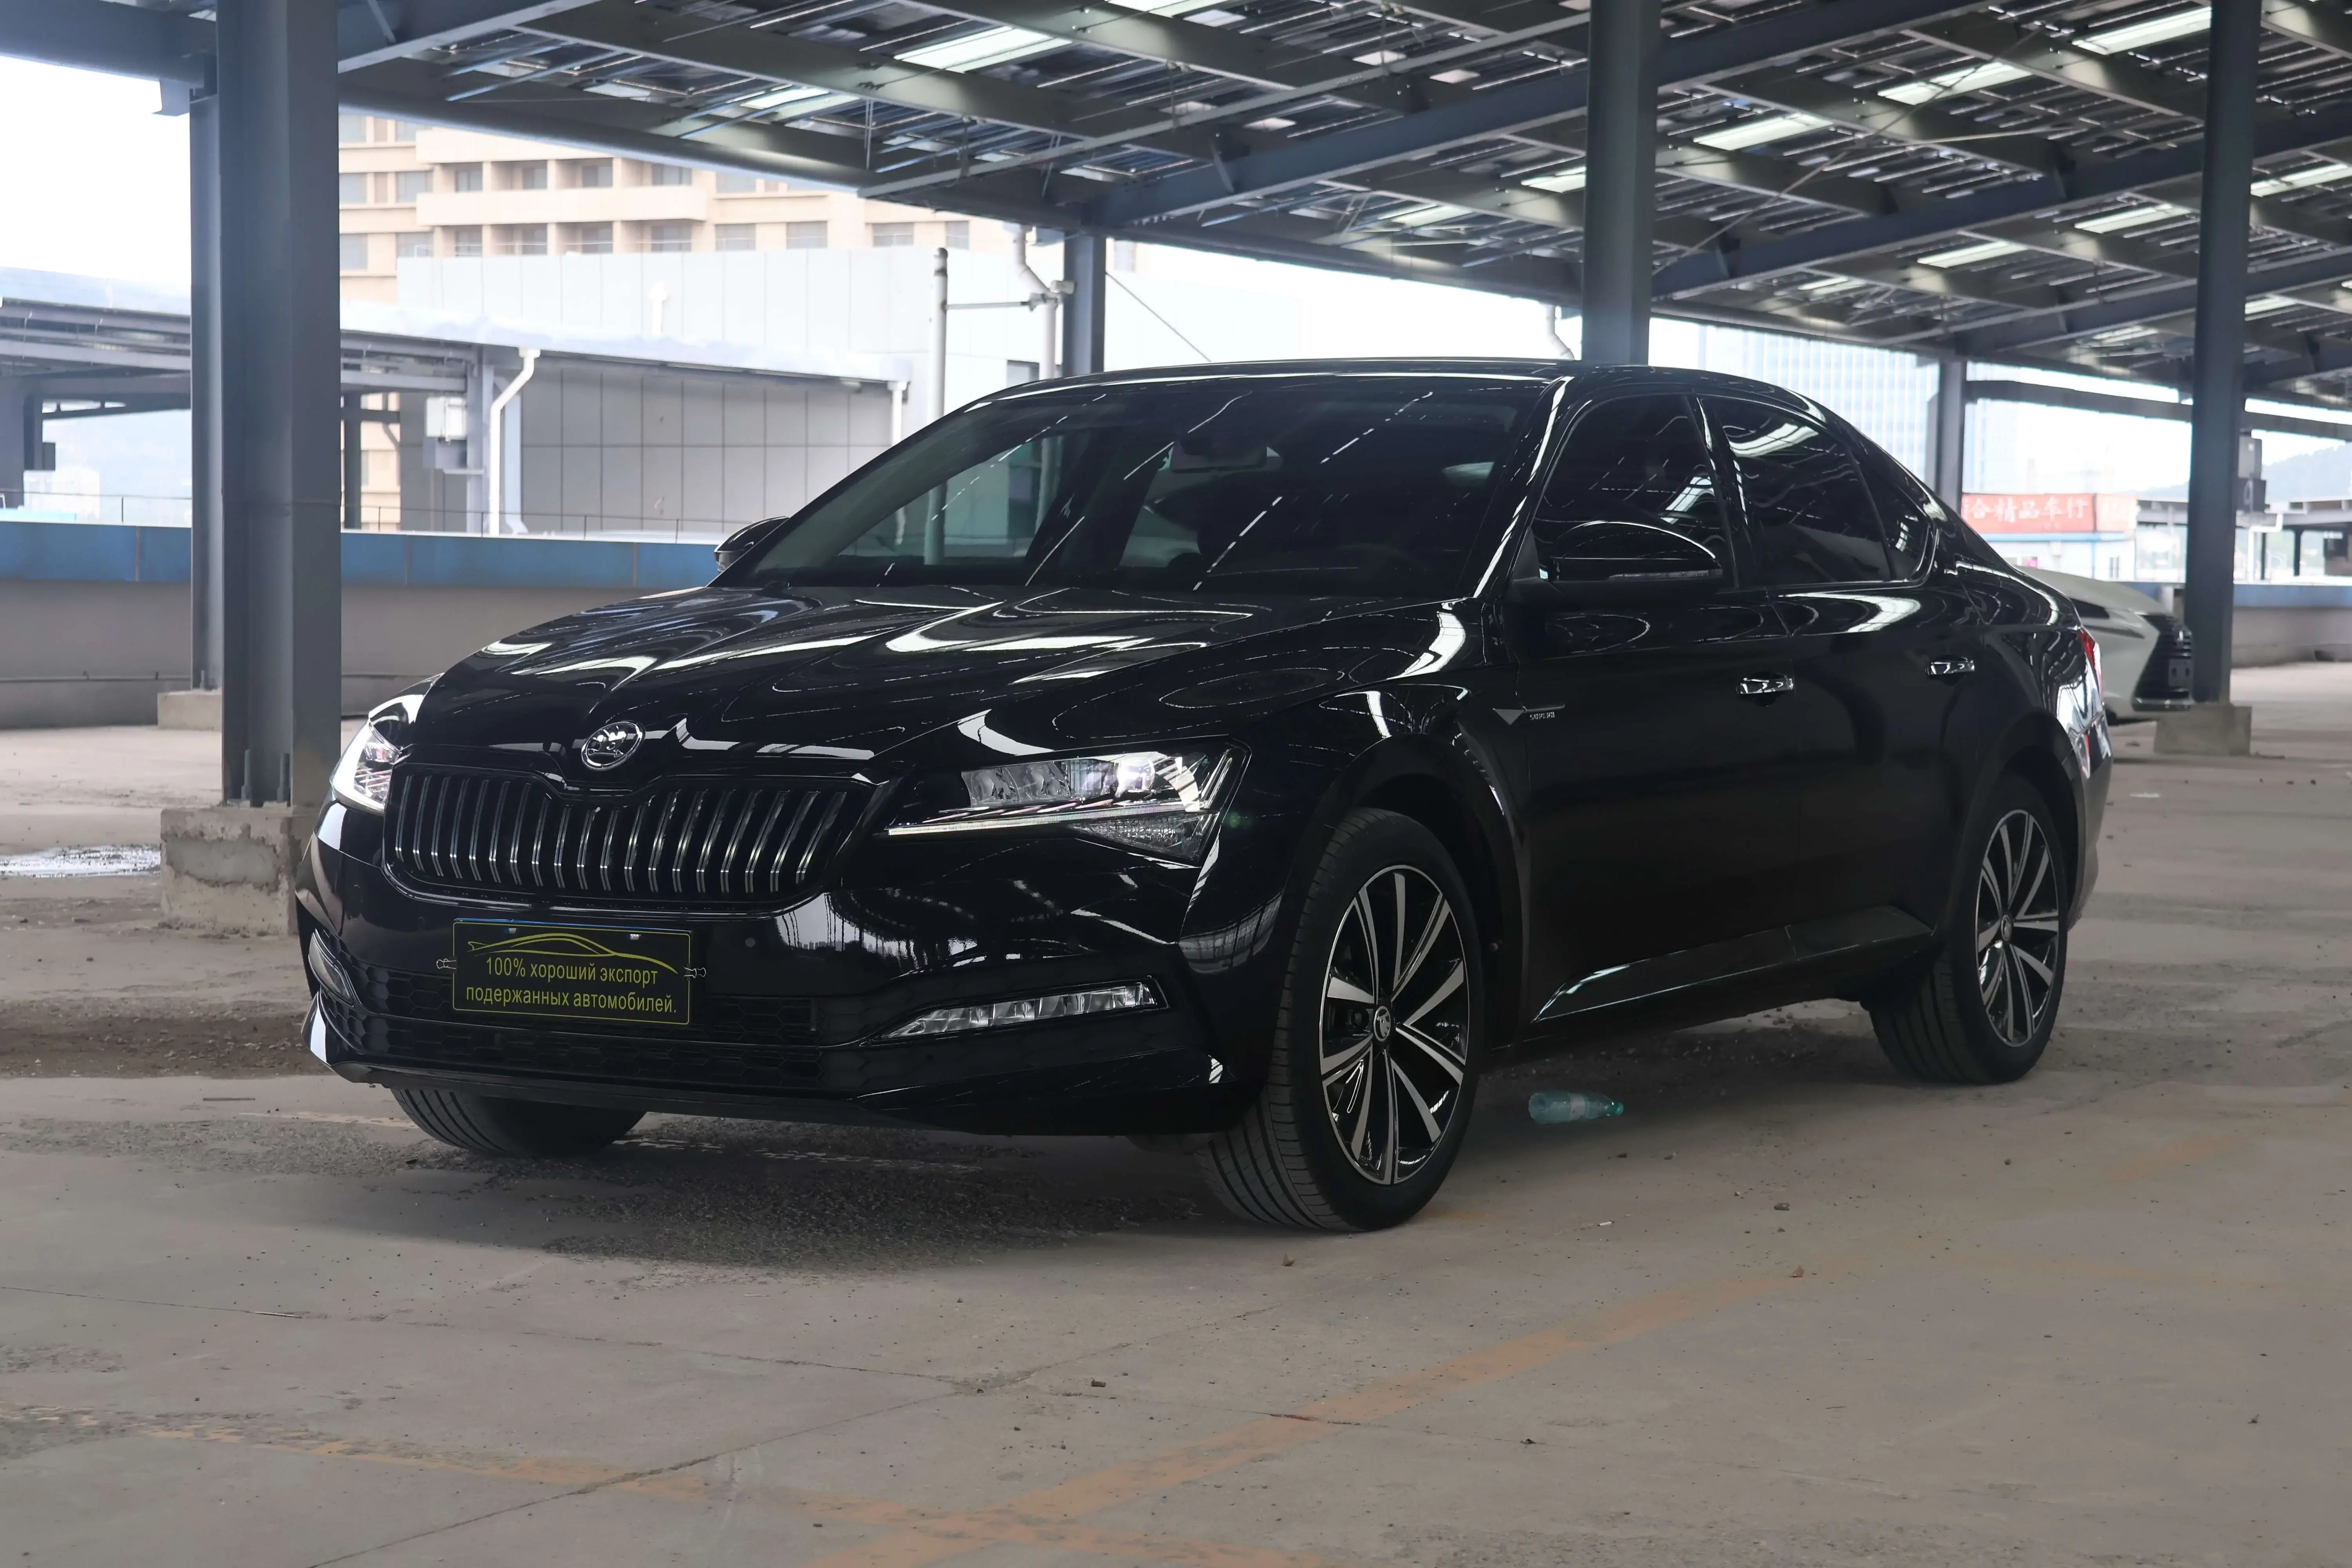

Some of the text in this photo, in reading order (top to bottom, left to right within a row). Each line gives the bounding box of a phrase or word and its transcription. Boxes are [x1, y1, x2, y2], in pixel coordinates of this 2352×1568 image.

[486, 957, 657, 987] 100% хороший экспорт
[466, 987, 677, 1013] подержанных автомобилей.
